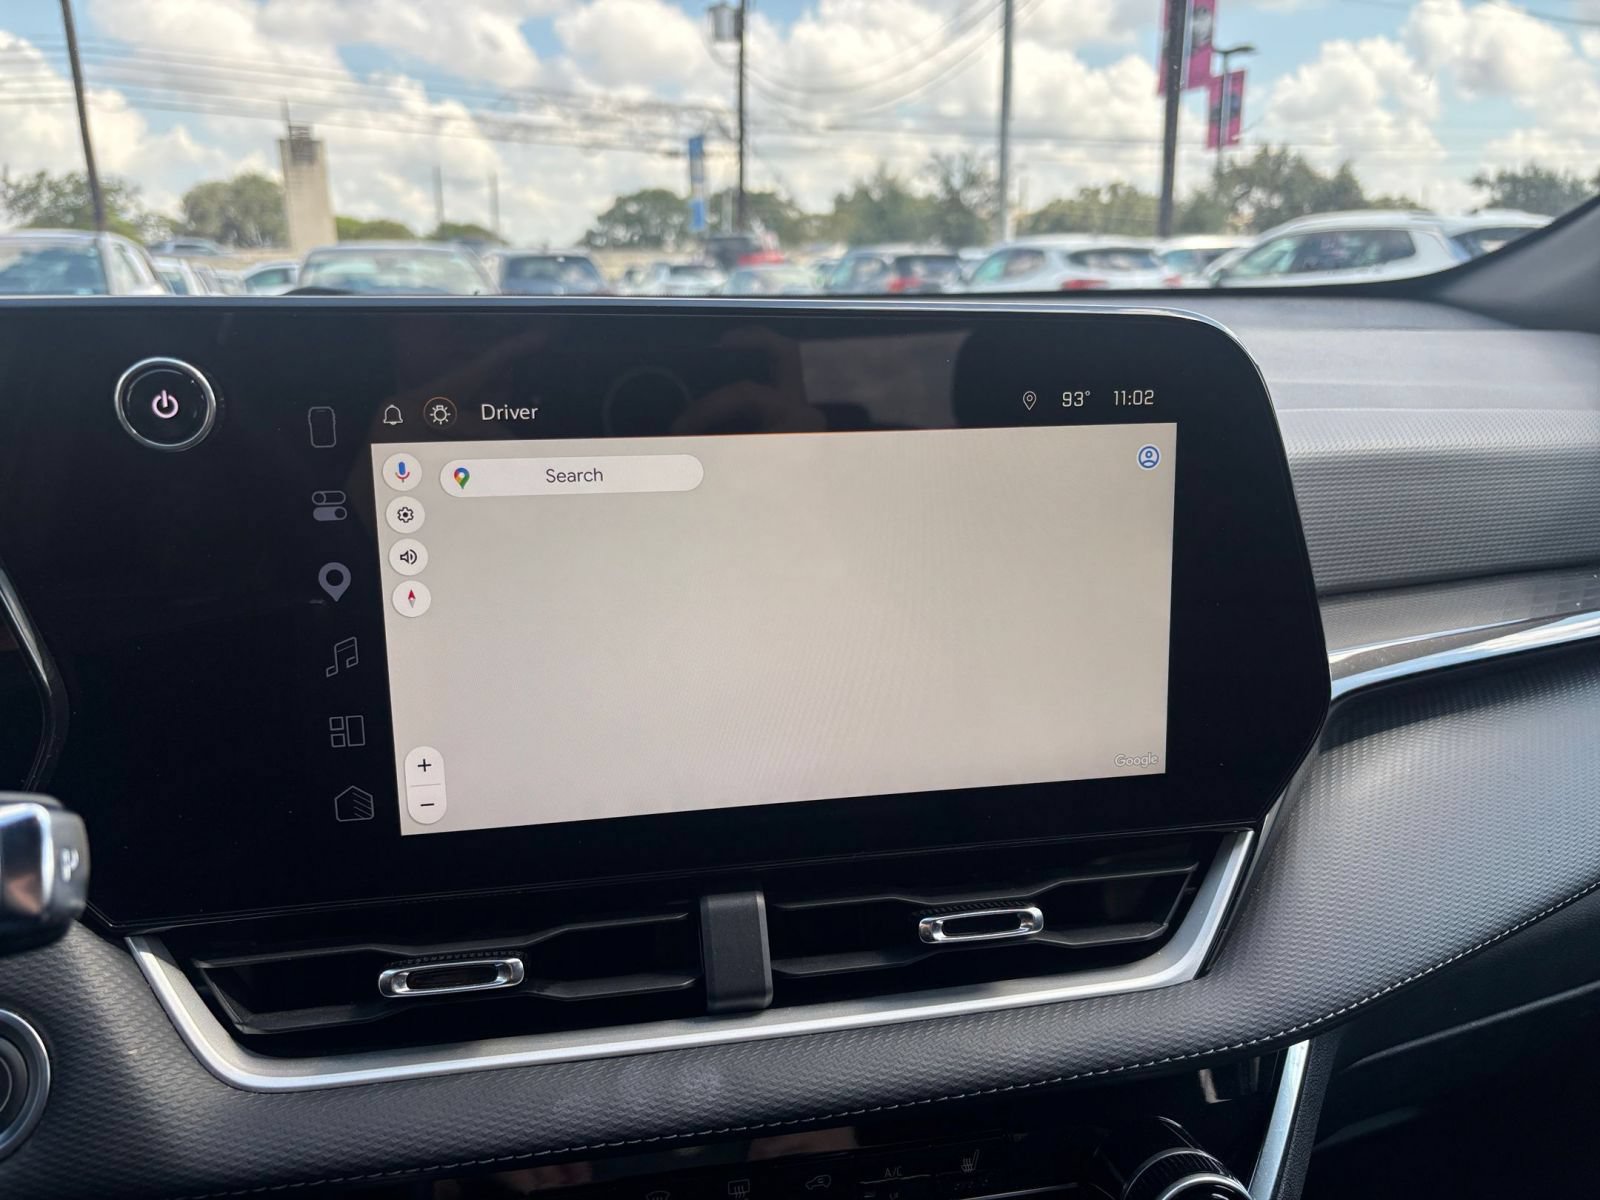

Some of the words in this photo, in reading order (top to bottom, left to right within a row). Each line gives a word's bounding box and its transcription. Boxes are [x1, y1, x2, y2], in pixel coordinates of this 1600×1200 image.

[1113, 389, 1155, 407] 11:02
[480, 402, 539, 421] Driver
[544, 466, 604, 483] Search
[1114, 751, 1160, 769] Google
